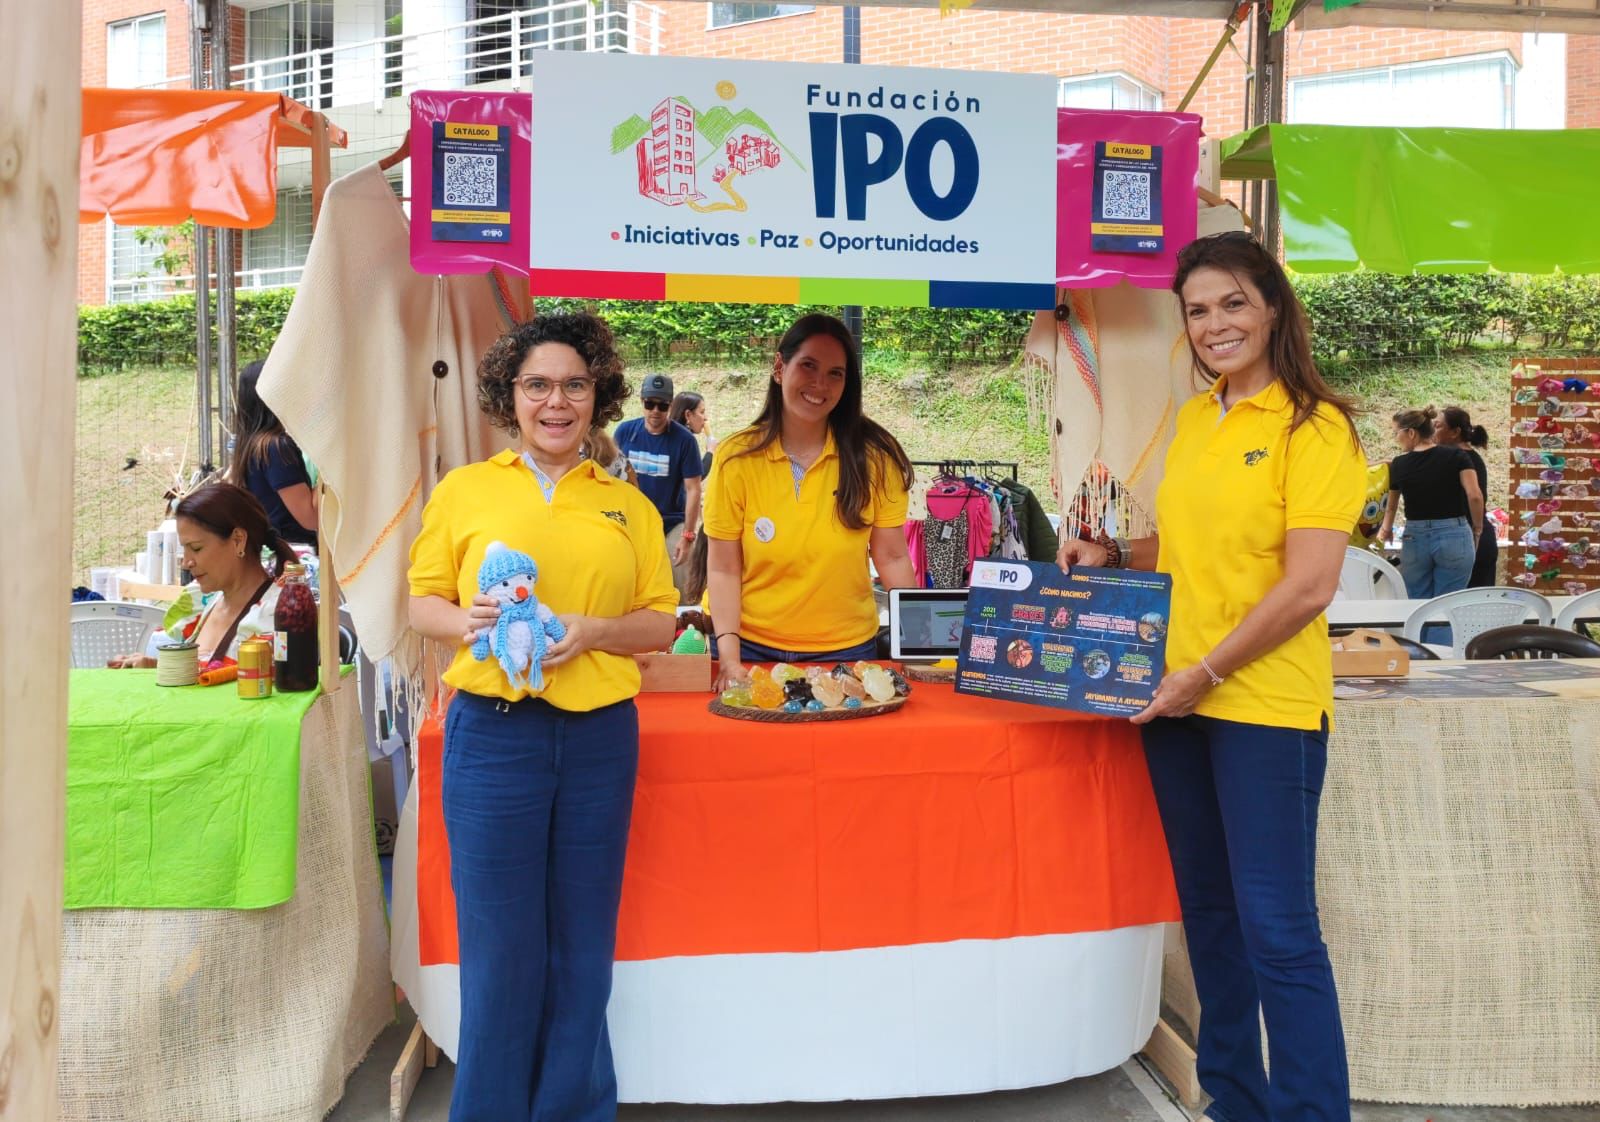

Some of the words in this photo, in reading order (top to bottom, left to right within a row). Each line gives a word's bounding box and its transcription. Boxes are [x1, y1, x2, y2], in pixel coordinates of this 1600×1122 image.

[807, 84, 980, 113] Fundación
[809, 111, 980, 221] IPO
[625, 224, 740, 247] Iniciativas
[760, 229, 799, 249] Paz
[819, 231, 979, 254] Oportunidades
[999, 569, 1018, 584] IPO
[1071, 574, 1090, 582] SOMOS
[982, 606, 996, 614] 2021
